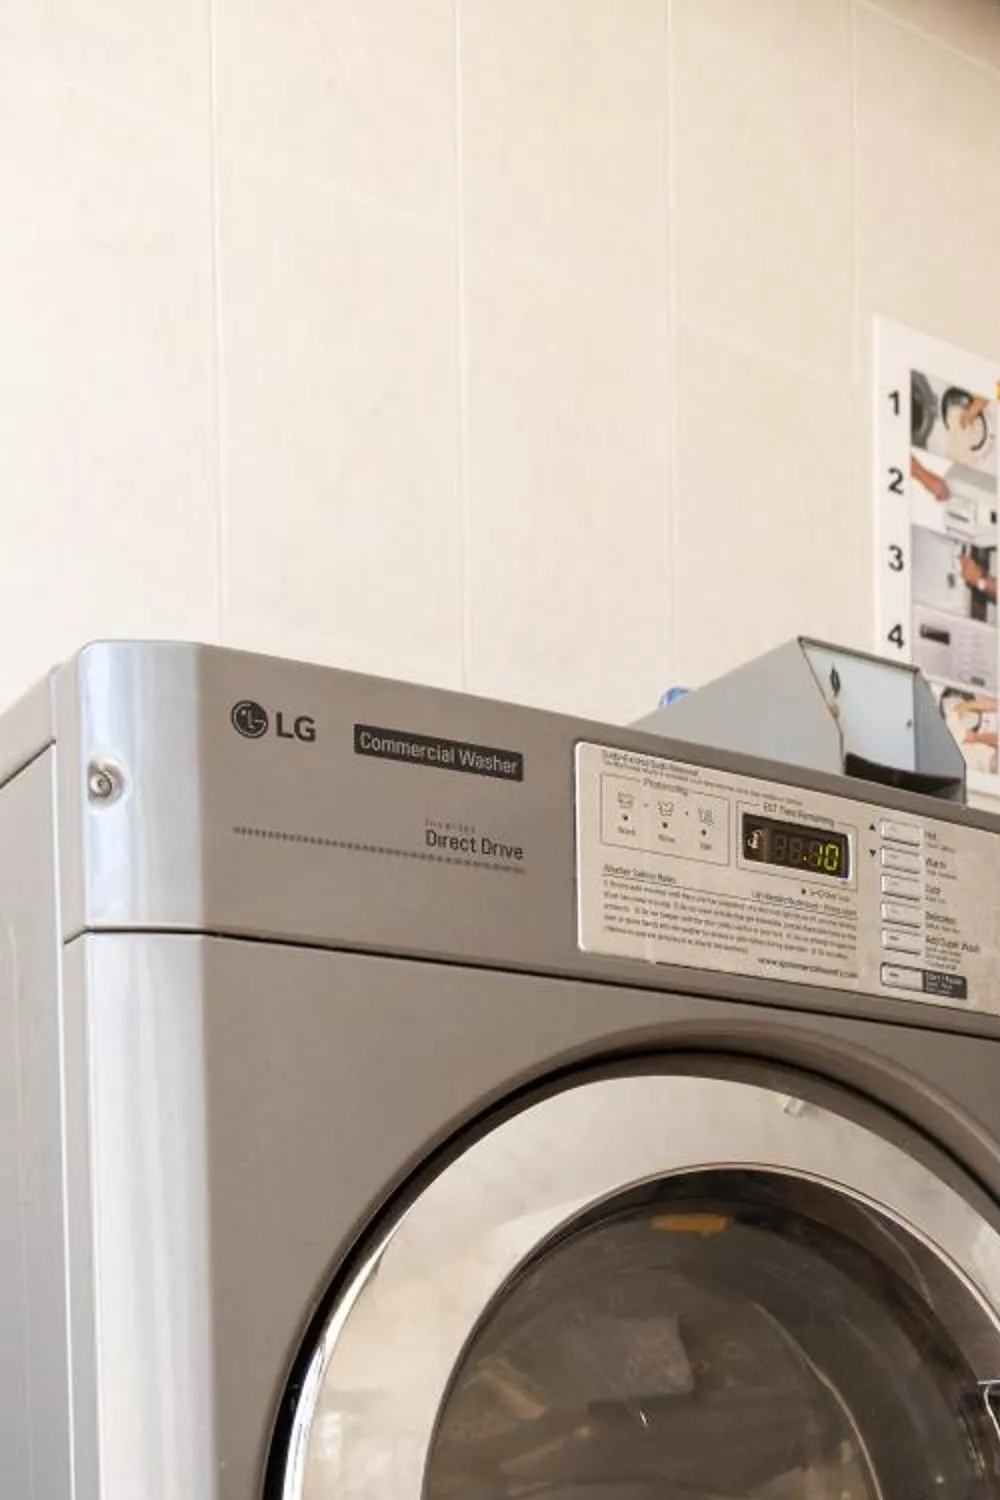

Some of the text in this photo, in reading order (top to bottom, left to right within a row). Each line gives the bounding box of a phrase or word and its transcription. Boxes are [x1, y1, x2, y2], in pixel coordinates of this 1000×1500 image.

[888, 390, 900, 416] 1
[888, 467, 904, 495] 2
[888, 545, 904, 572] 3
[887, 623, 905, 649] 4
[276, 712, 317, 742] LG
[359, 731, 519, 775] Commercial Washer
[425, 829, 524, 861] Direct Drive
